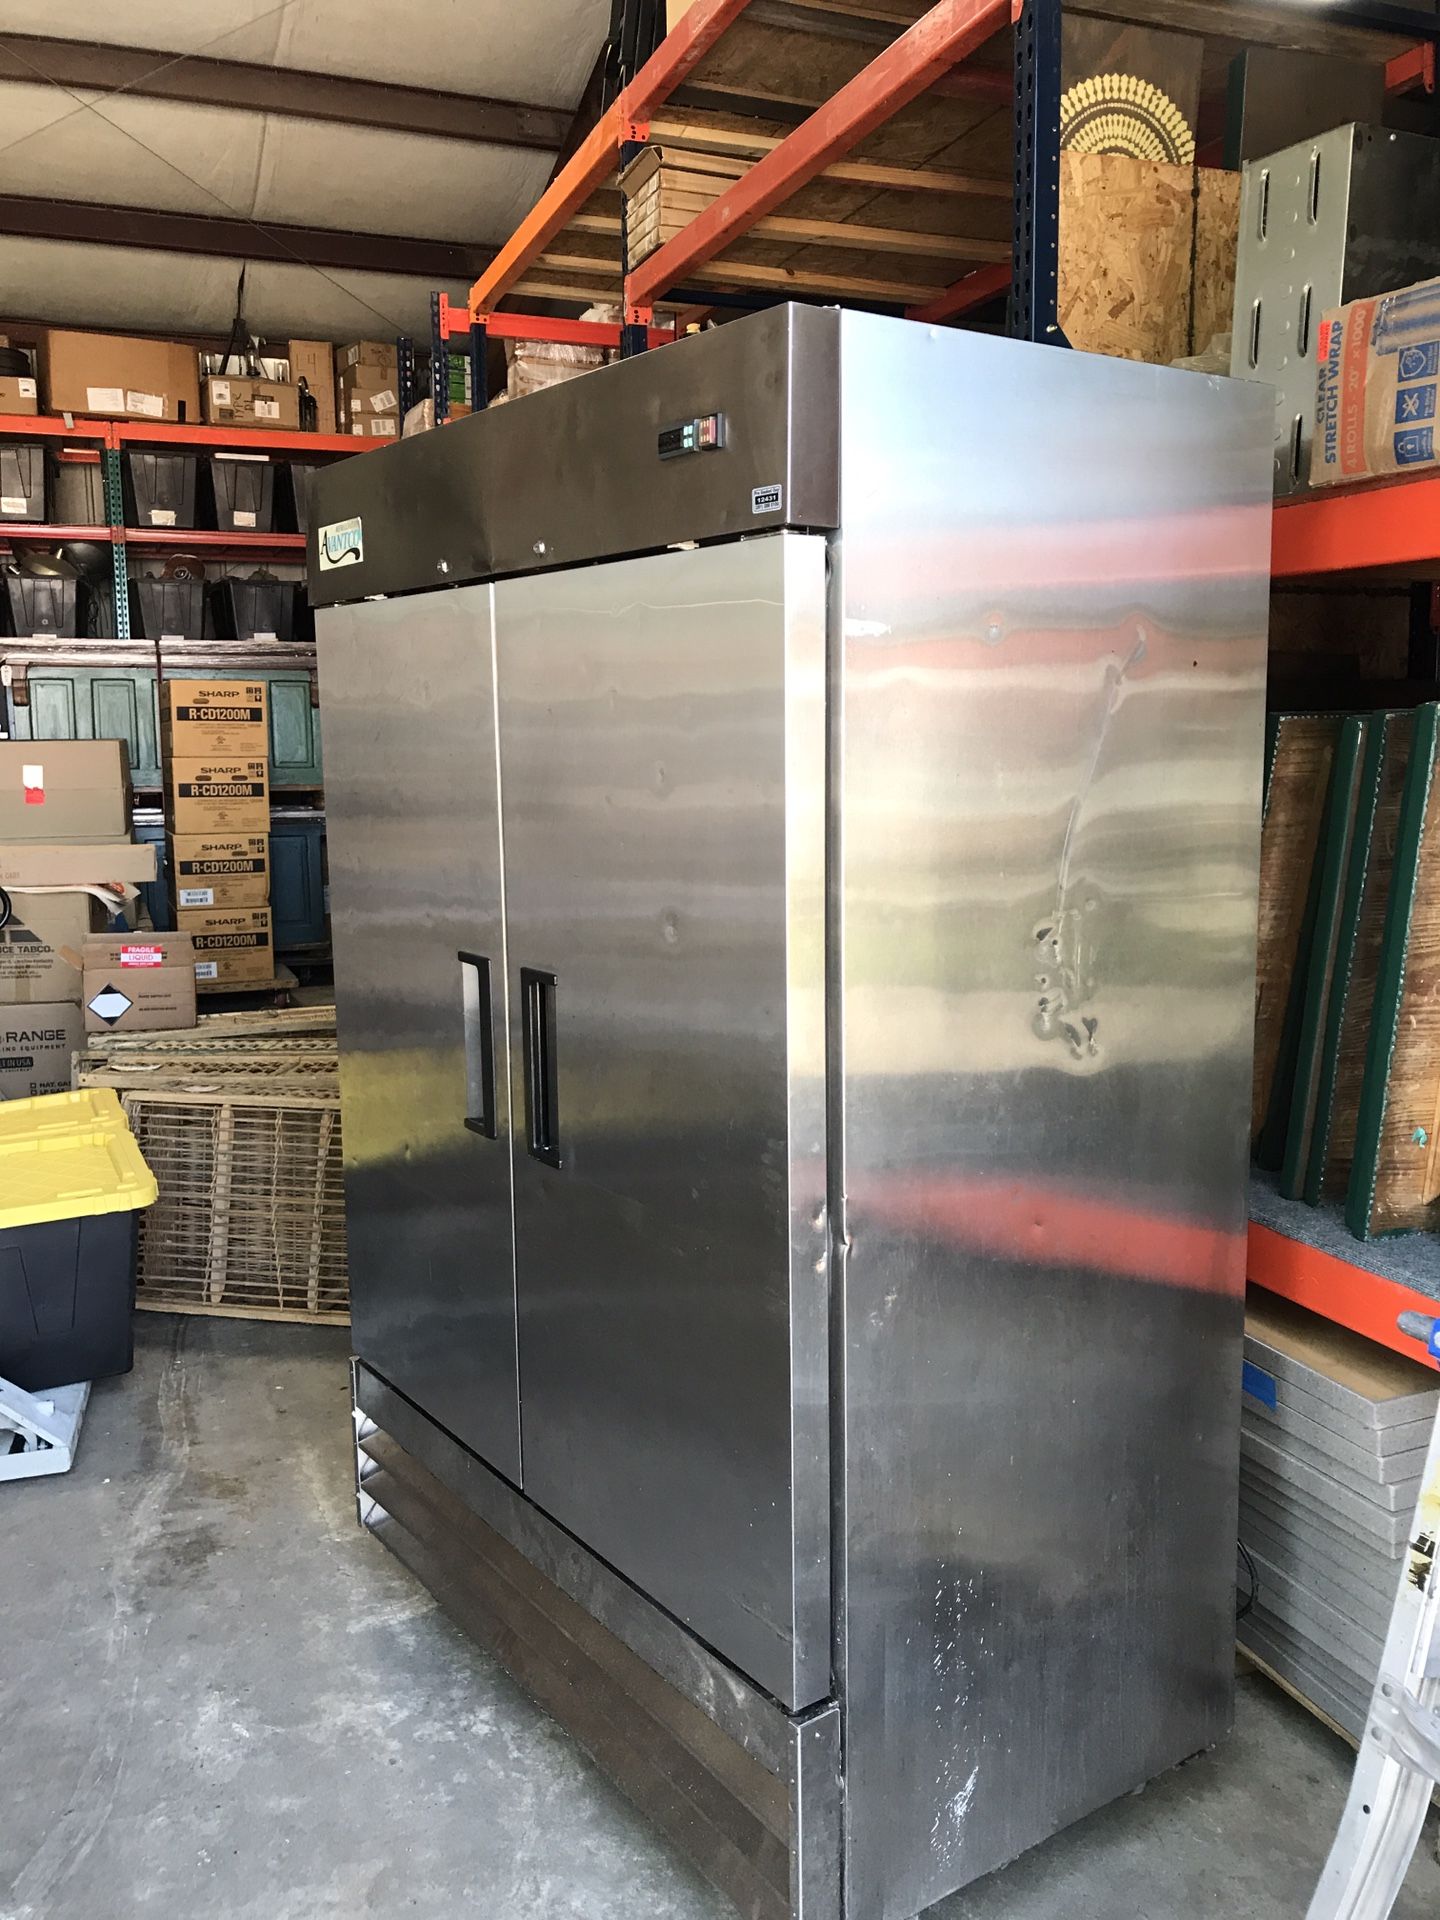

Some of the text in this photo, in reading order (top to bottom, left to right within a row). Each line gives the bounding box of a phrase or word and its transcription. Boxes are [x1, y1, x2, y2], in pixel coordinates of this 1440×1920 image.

[1316, 367, 1328, 424] CLEAR
[1325, 320, 1344, 464] STRETCH WRAP
[1346, 404, 1359, 454] ROLLS
[1347, 457, 1358, 469] 4
[198, 690, 240, 698] SHARP
[188, 708, 251, 720] R-CD1200M
[190, 784, 253, 796] R-CD1200M
[201, 843, 242, 851] SHARP
[192, 860, 254, 873] R-CD1200M
[205, 918, 246, 926] SHARP
[196, 934, 257, 948] R-CD1200M
[6, 1029, 67, 1043] RANGE
